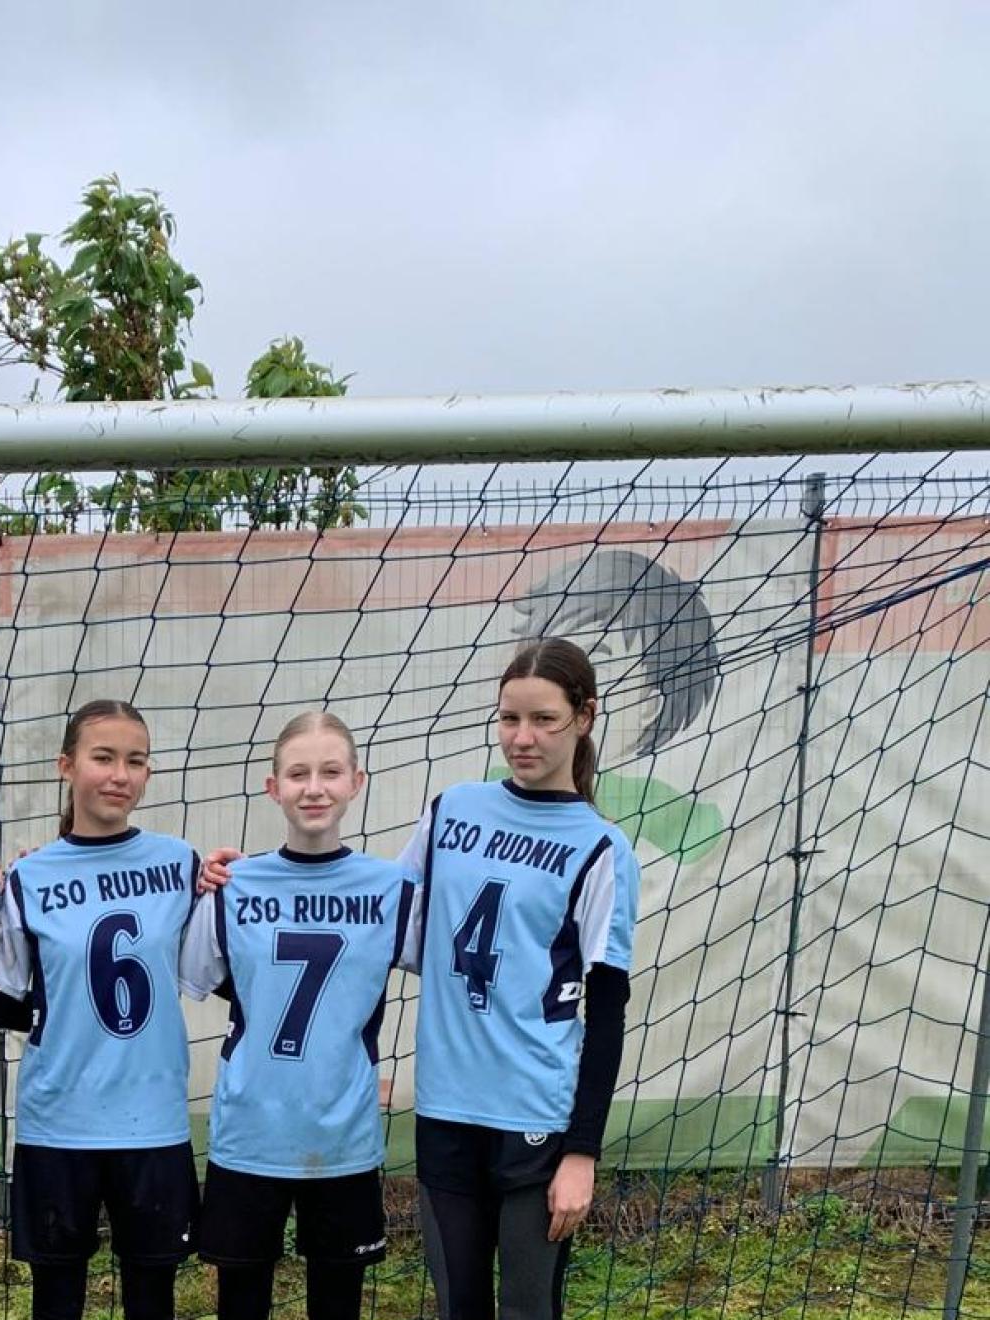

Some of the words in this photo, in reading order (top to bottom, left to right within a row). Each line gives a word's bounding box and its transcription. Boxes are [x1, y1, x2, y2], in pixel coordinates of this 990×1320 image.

[37, 876, 86, 915] ZSO
[97, 862, 185, 901] RUDNIK
[437, 818, 481, 853] ZSO
[483, 828, 577, 878] RUDNIK
[236, 896, 281, 926] ZSO
[293, 894, 385, 926] RUDNIK
[451, 875, 510, 1016] 4
[85, 908, 156, 1040] 6
[270, 927, 350, 1062] 7
